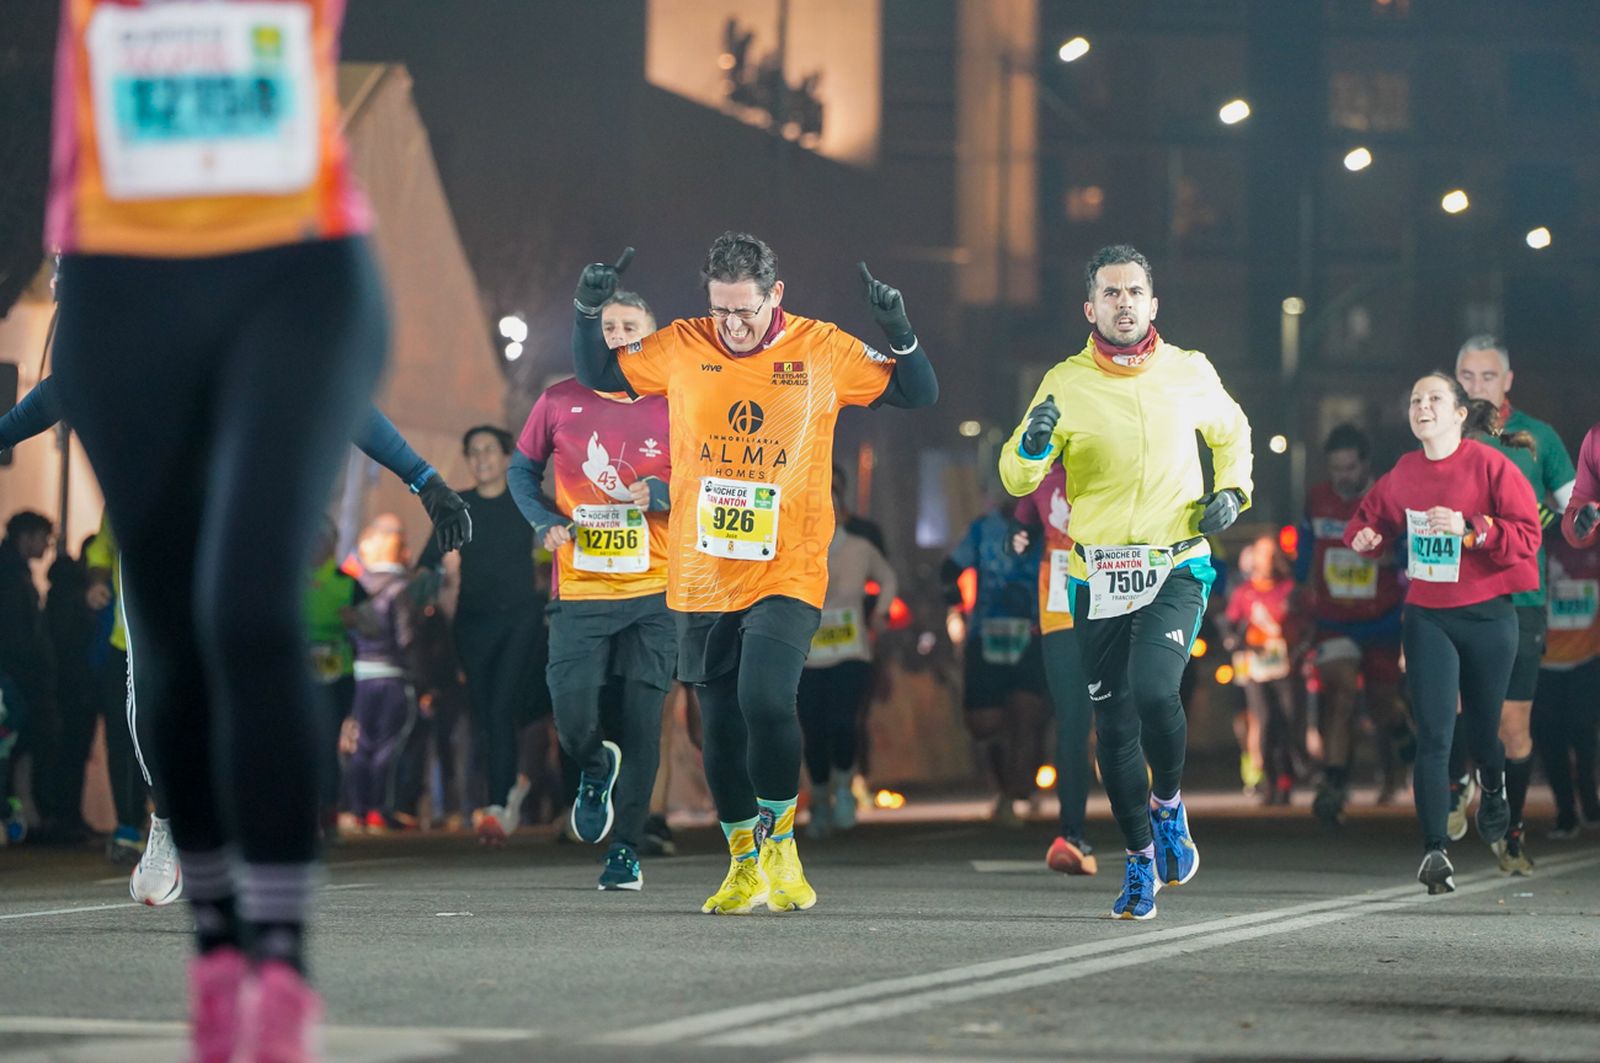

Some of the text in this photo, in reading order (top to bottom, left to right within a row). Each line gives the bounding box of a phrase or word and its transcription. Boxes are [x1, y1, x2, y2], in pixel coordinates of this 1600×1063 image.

[709, 434, 780, 445] INMOBILIARIA
[699, 442, 788, 468] ALMA
[715, 468, 766, 480] HOMES
[598, 471, 617, 491] 43
[713, 487, 747, 498] NOCHE DE
[707, 494, 718, 504] SAN
[718, 496, 747, 507] ANTÓN
[712, 506, 755, 533] 926
[584, 529, 638, 550] 12756
[1105, 550, 1142, 560] NOCHE DE
[1096, 560, 1114, 570] SAN
[1114, 559, 1142, 570] ANTÓN
[1105, 569, 1158, 593] 7504
